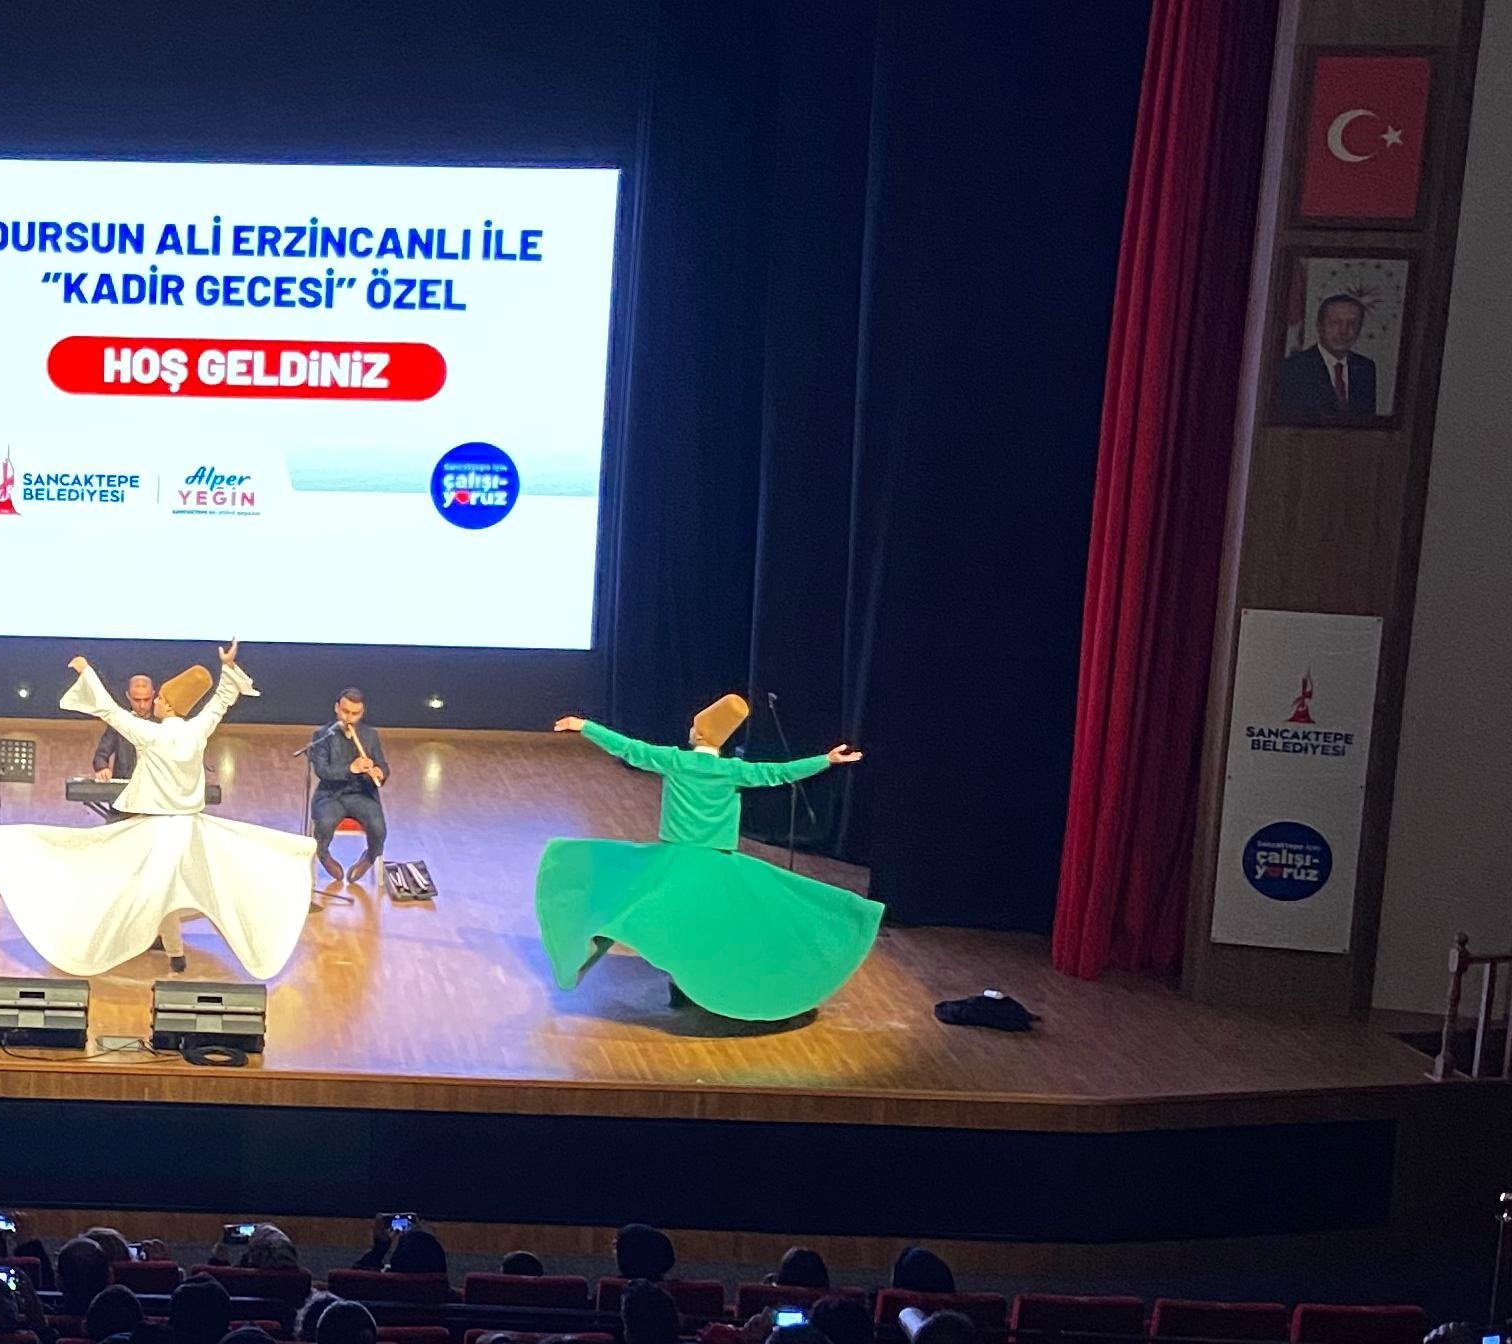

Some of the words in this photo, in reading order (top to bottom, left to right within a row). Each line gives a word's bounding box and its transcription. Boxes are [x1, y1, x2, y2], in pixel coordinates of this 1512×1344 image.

[155, 215, 221, 256] ALİ
[232, 216, 471, 261] ERZİNCANLI
[481, 219, 544, 262] İLE
[366, 267, 467, 312] ÖZEL
[103, 347, 189, 394] HOŞ
[197, 349, 391, 389] GELDİNİZ
[22, 473, 140, 488] SANCAKTEPE
[184, 465, 252, 492] Alper
[22, 488, 125, 503] BELEDİYESİ
[178, 486, 255, 506] YEĞİN
[1246, 726, 1355, 745] SANCAKTEPE
[1251, 738, 1347, 756] BELEDİYESİ
